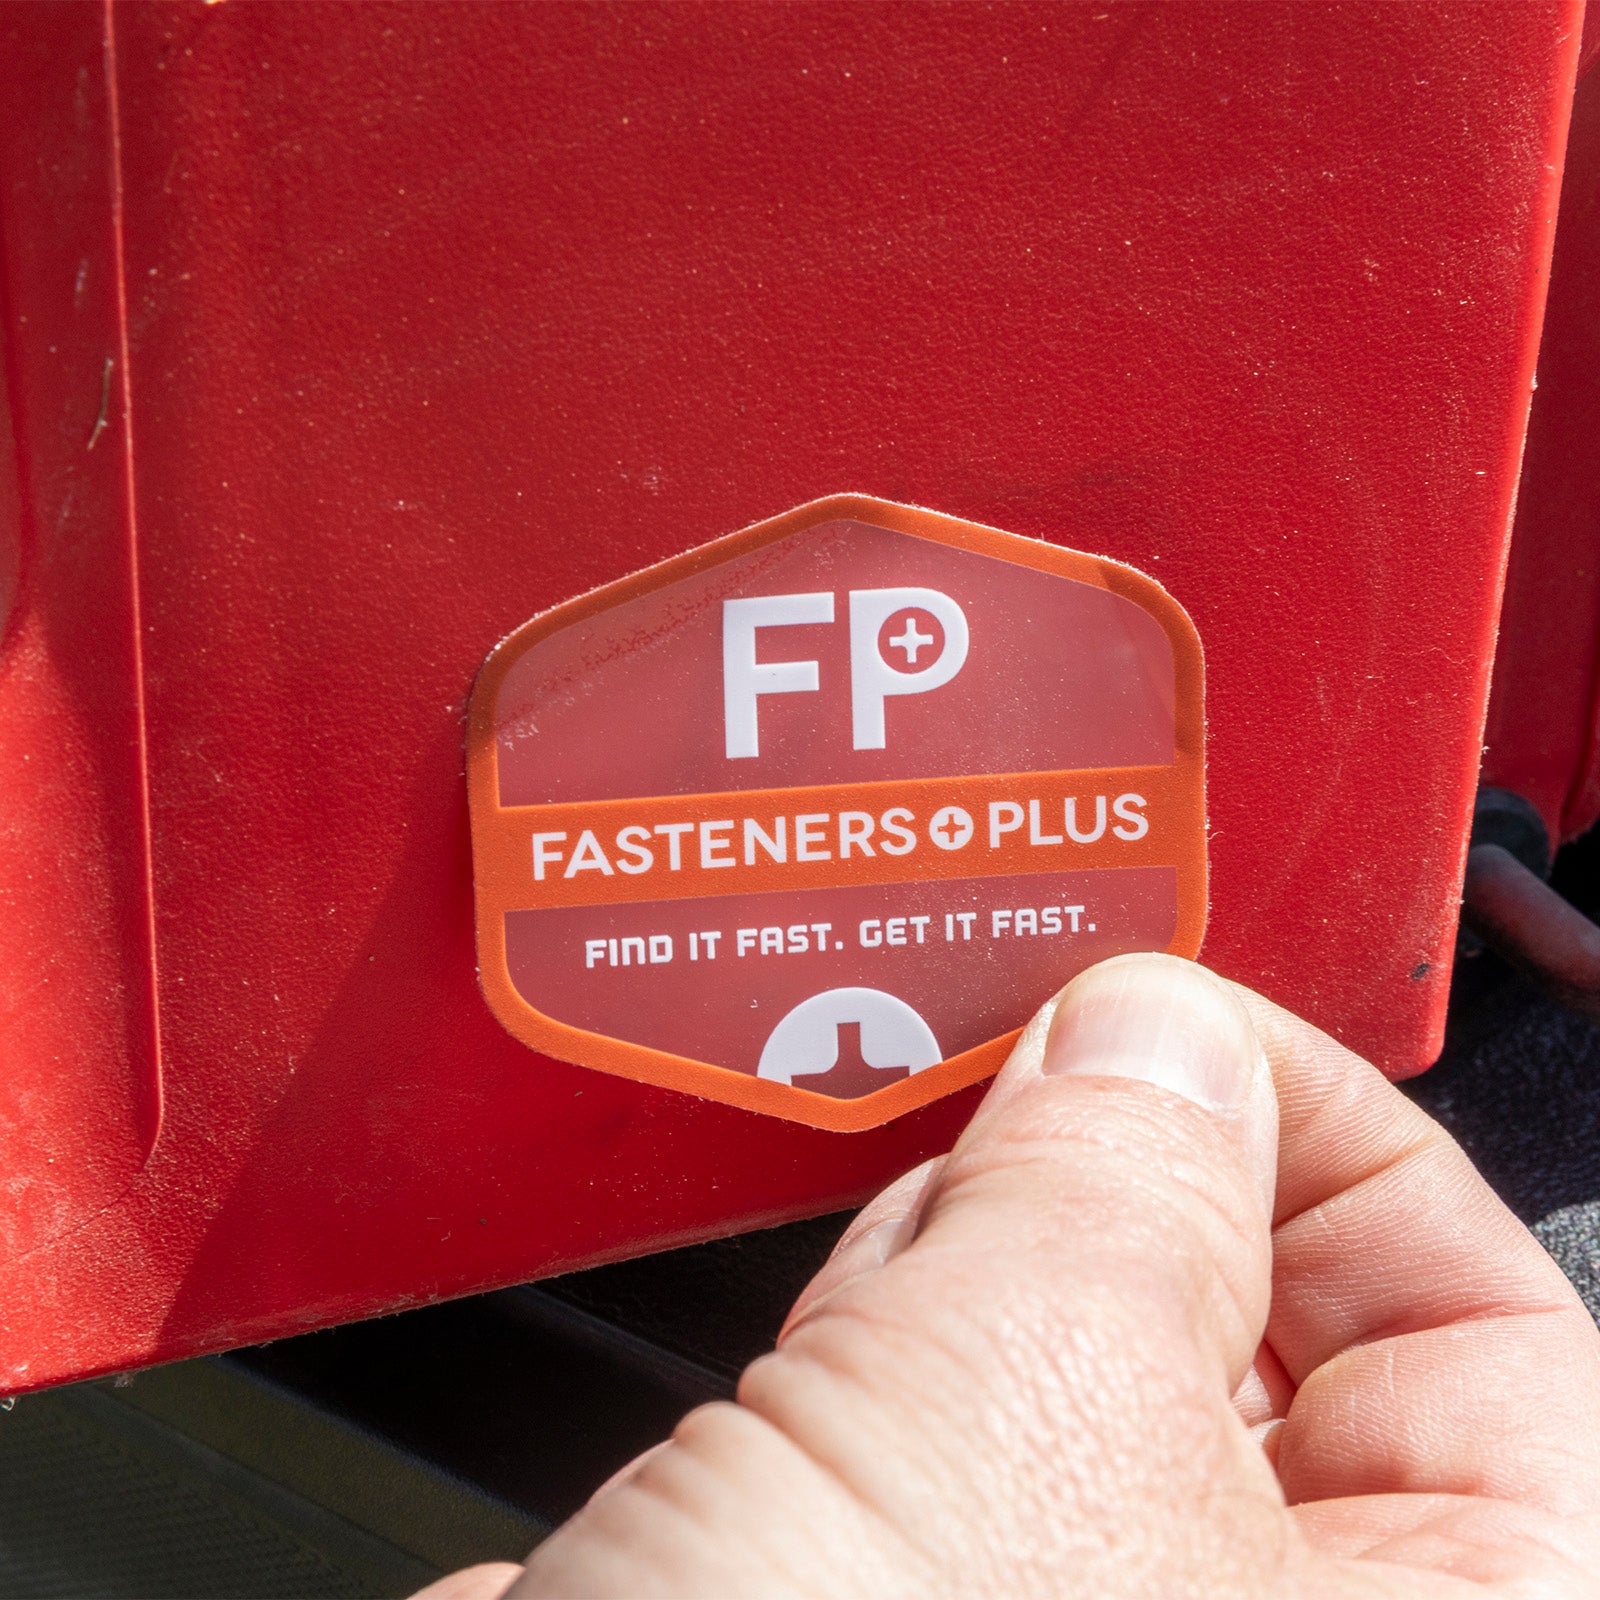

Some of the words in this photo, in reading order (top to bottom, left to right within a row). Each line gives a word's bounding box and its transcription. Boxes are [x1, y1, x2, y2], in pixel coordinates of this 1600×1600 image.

[722, 586, 970, 759] FP
[532, 807, 918, 881] FASTENERS
[988, 792, 1149, 849] PLUS
[688, 930, 722, 961] IT
[736, 922, 844, 957] FAST.
[859, 914, 931, 948] GET
[944, 911, 978, 942] IT
[991, 904, 1097, 938] FAST.
